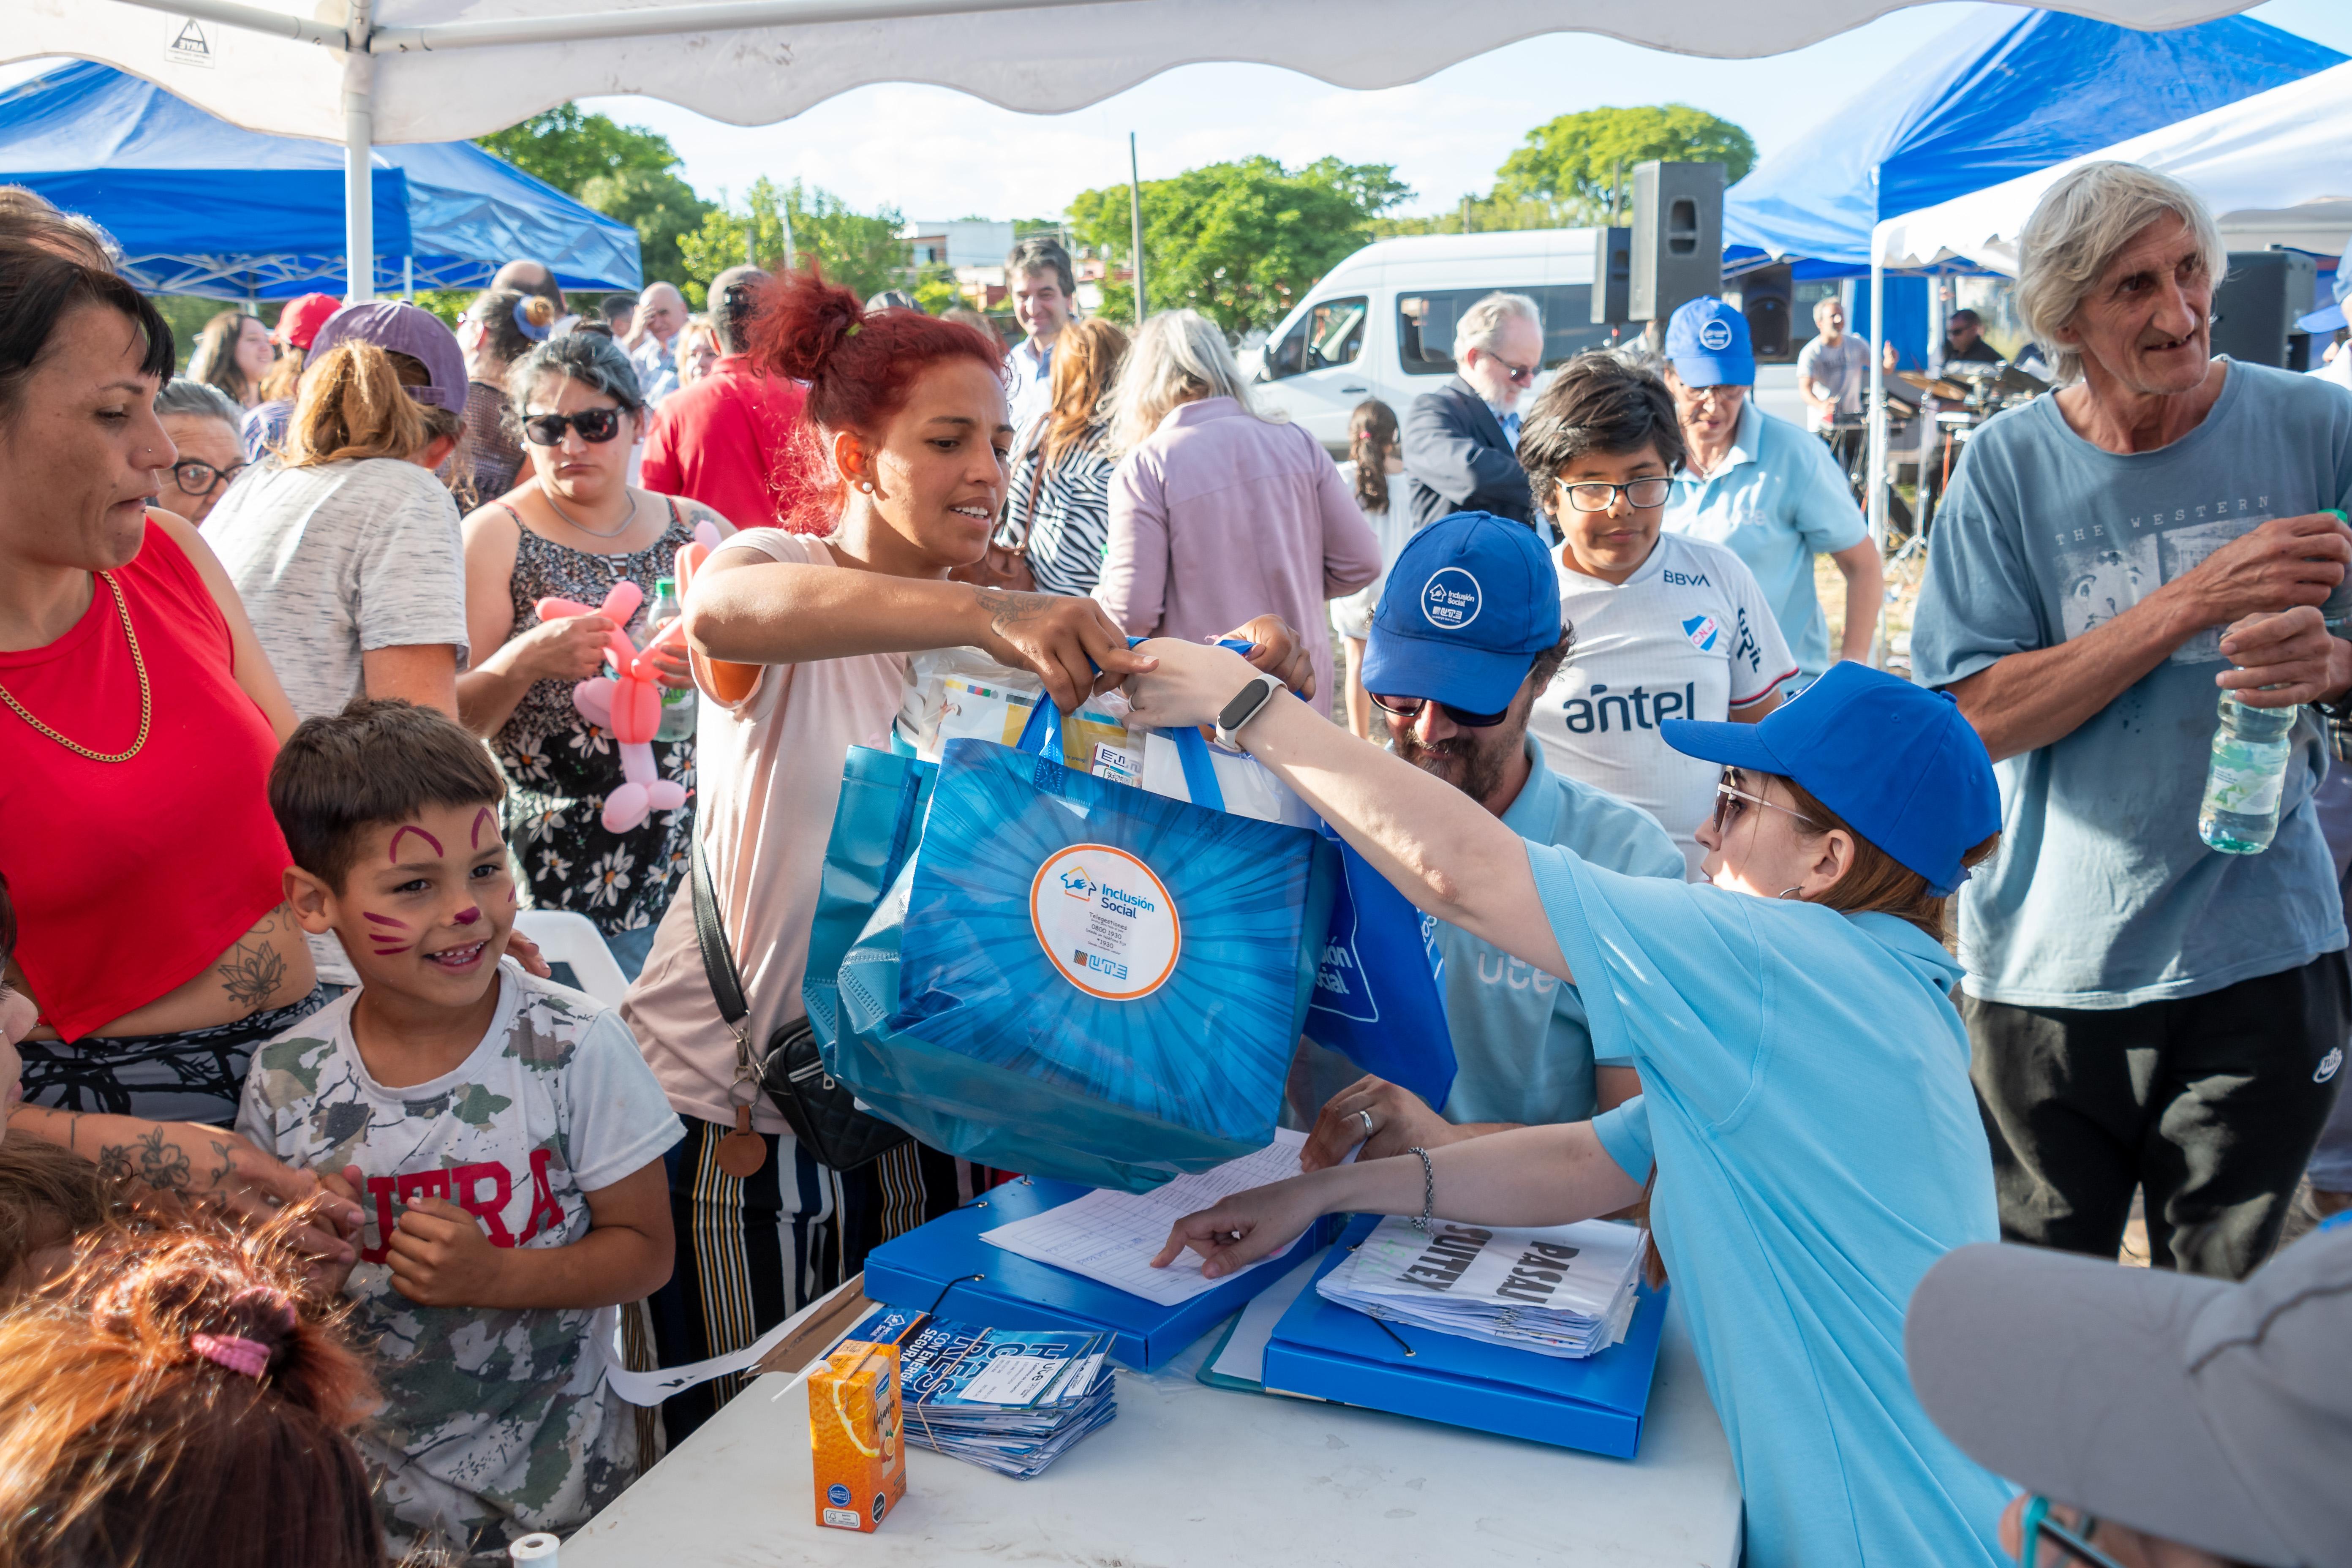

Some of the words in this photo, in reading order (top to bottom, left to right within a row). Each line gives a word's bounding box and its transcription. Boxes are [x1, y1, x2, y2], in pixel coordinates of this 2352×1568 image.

[2055, 525, 2104, 546] THE
[2131, 496, 2268, 529] WESTERN
[1663, 569, 1711, 587] BBVA
[1448, 590, 1475, 602] Inclusión
[1448, 597, 1466, 607] Social
[1563, 681, 1695, 734] antel
[1101, 897, 1137, 919] Social
[1102, 883, 1155, 912] Inclusión
[1089, 912, 1127, 930] Telegestiones
[1092, 924, 1106, 934] 0800
[1108, 931, 1122, 939] 1930
[1089, 954, 1128, 980] UTE
[1395, 1225, 1493, 1292] SUITEX
[900, 1328, 938, 1362] SEGURA
[928, 1332, 950, 1351] CON
[900, 1350, 934, 1386] ENERGÍ
[1031, 1363, 1056, 1382] ute
[873, 1394, 896, 1435] Naranja
